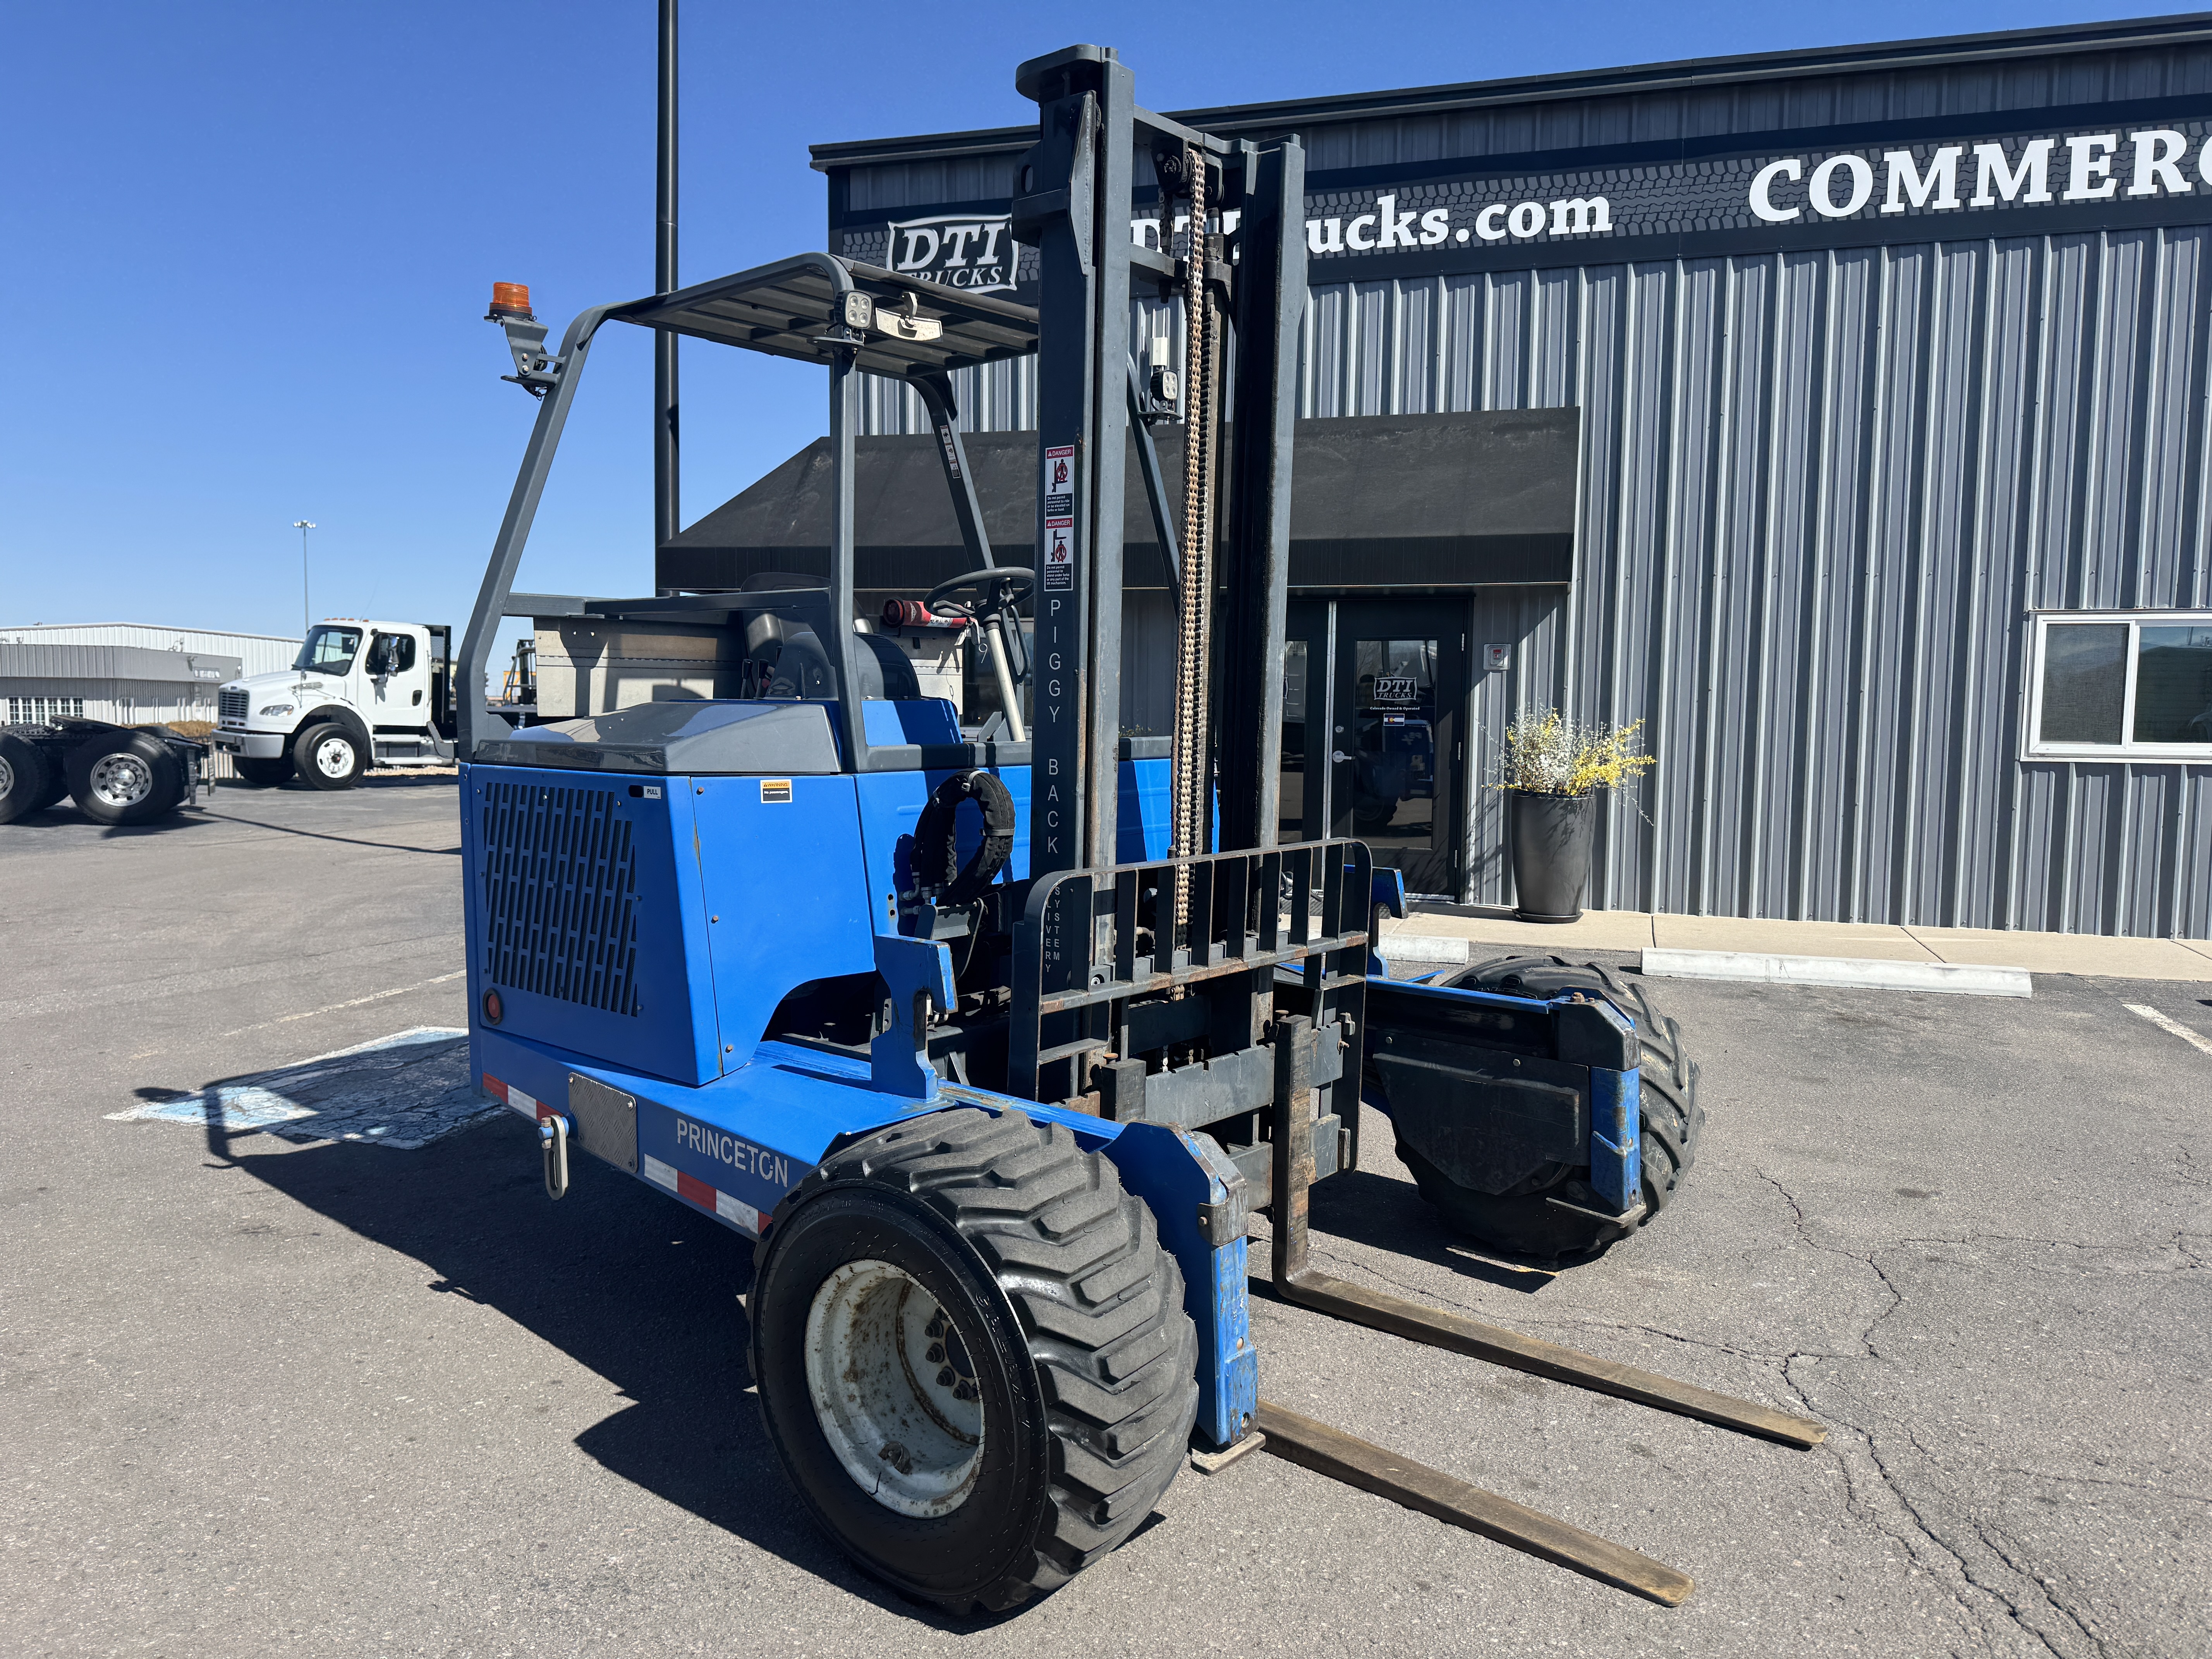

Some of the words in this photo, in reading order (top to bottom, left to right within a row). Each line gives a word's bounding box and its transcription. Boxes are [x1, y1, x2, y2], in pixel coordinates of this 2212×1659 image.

[1748, 129, 2212, 222] COMMER
[895, 222, 1007, 271] DTI
[1130, 194, 1613, 262] DTucks.com
[902, 266, 1003, 287] RUCKS
[1048, 599, 1061, 723] PIGGY
[1376, 680, 1414, 692] DTI
[1047, 758, 1059, 854] BACK
[677, 1118, 788, 1188] PRINCETON
